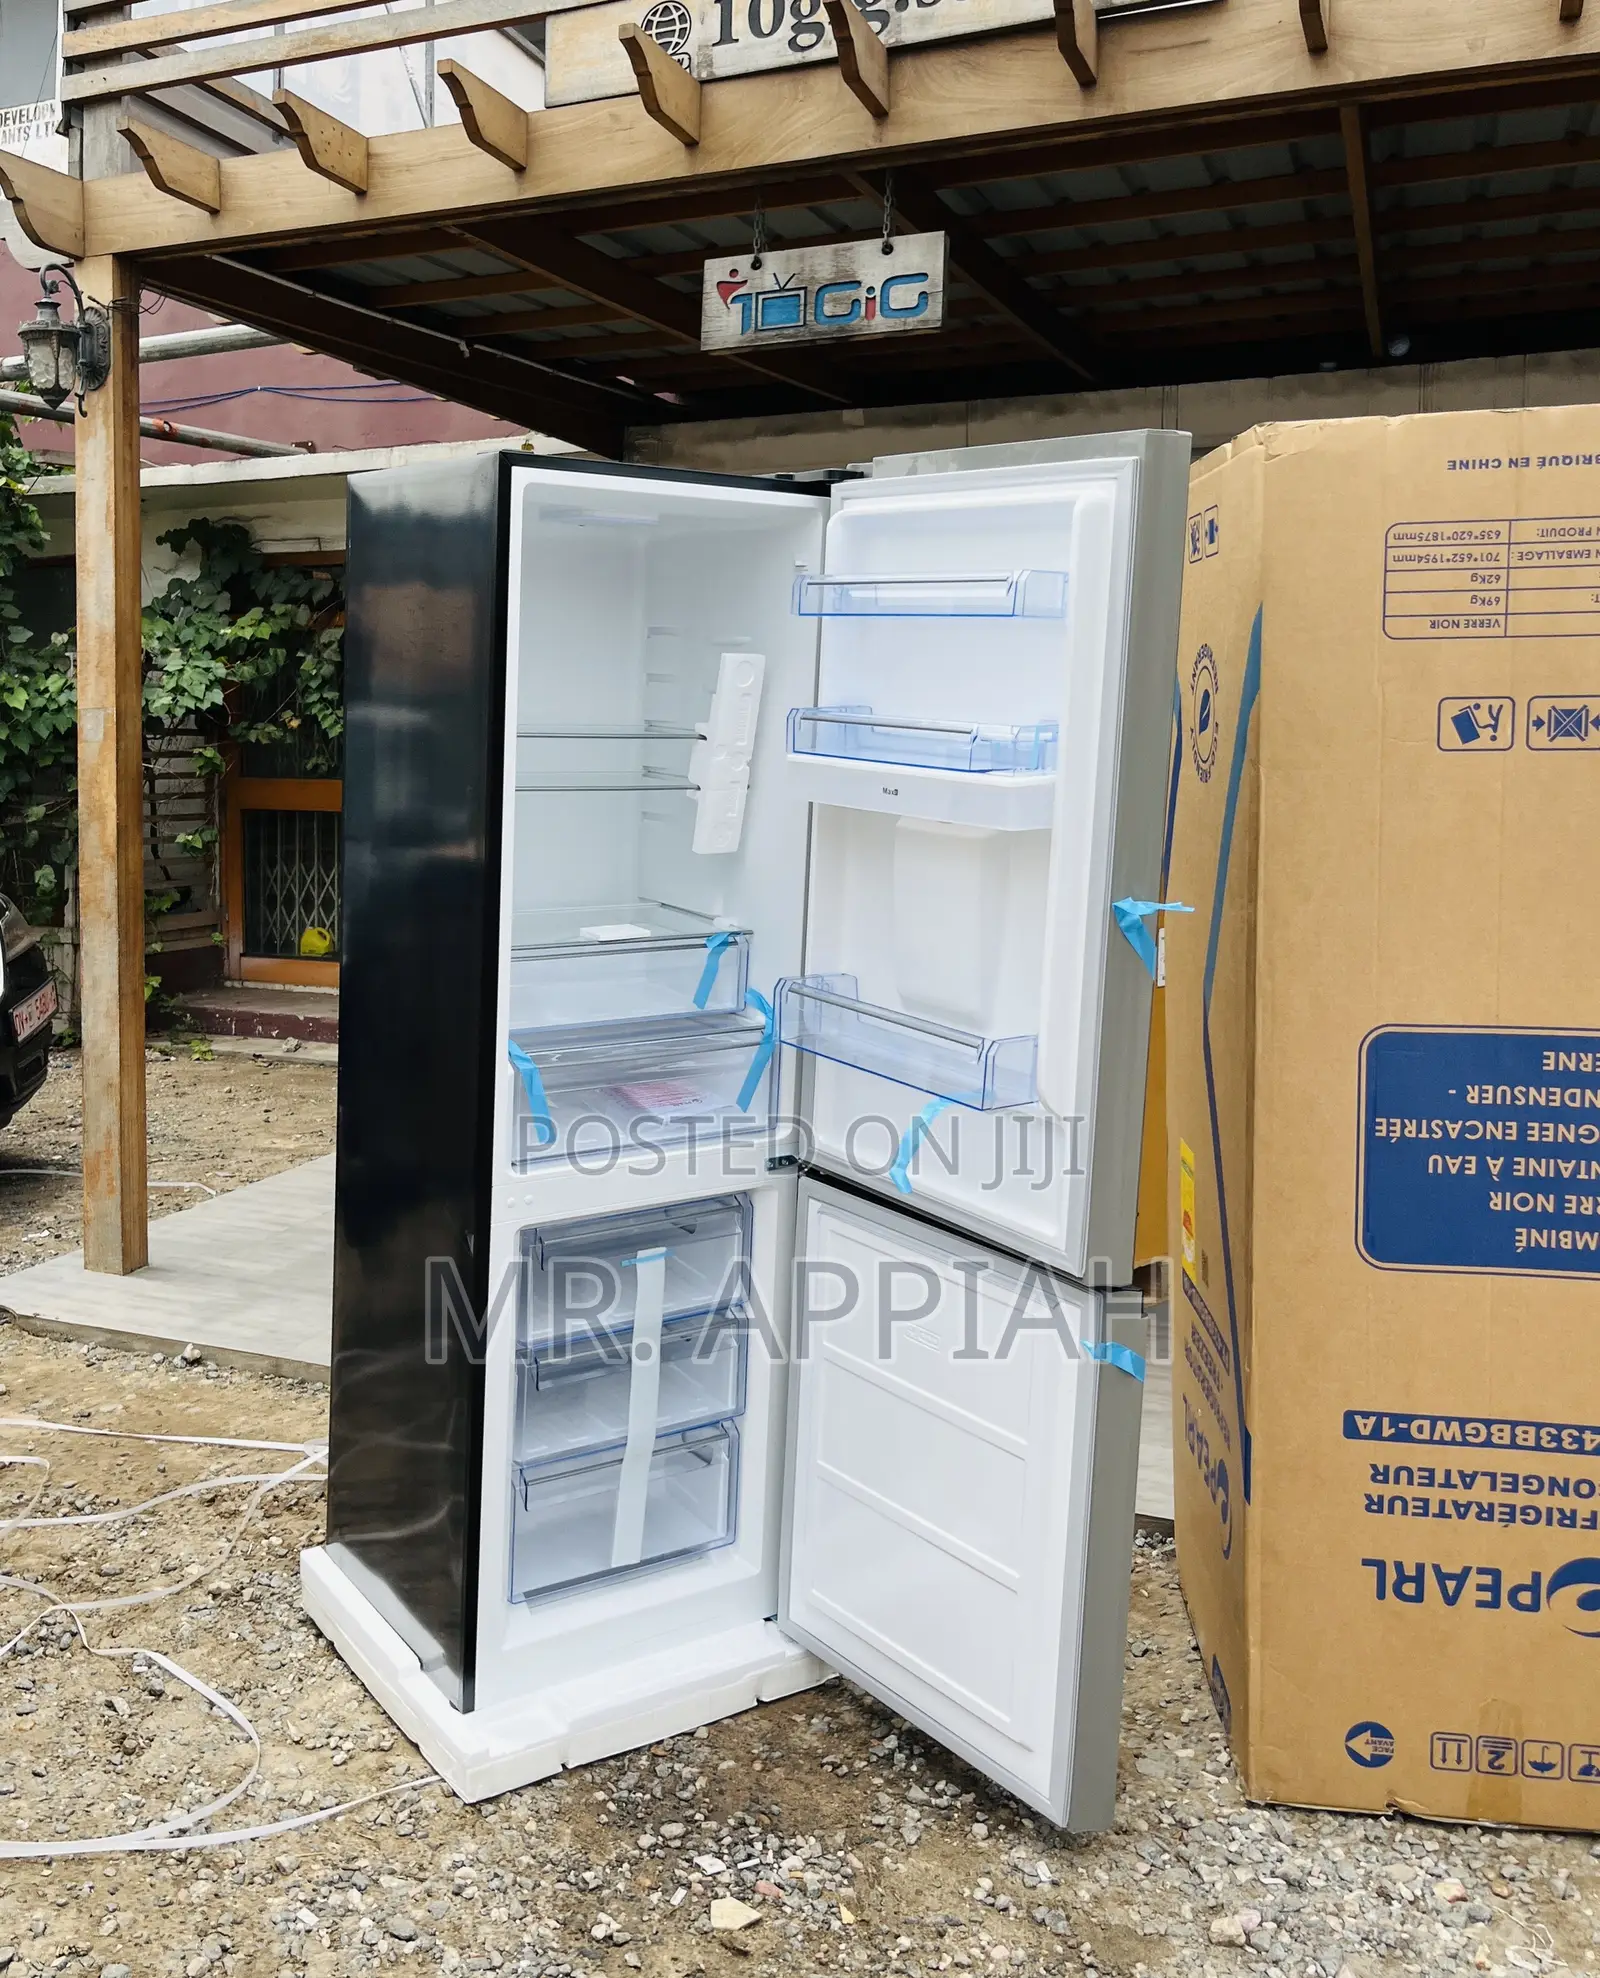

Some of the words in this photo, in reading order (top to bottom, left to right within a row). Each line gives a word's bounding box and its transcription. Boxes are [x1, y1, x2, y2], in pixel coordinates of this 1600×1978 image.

[1447, 458, 1502, 471] CHINE
[1508, 456, 1530, 469] EN
[1536, 526, 1592, 538] PRODUIT:
[1470, 572, 1501, 584] 62Kg
[1470, 594, 1501, 606] 69Kg
[1429, 619, 1460, 629] NOIR
[1464, 618, 1501, 629] VERRE
[1466, 1084, 1600, 1108] NDENSUER
[1375, 1117, 1517, 1144] ENCASTRÉE
[1527, 1122, 1600, 1145] GNEE
[1428, 1154, 1477, 1175] EAU
[1486, 1156, 1505, 1182] À
[1489, 1191, 1554, 1213] NOIR
[1515, 1227, 1599, 1253] MBINÉ
[1369, 1463, 1600, 1499] ONGELATEUR
[1364, 1493, 1600, 1530] FRIGÉRATEUR
[1361, 1558, 1542, 1613] PEARL
[1364, 1738, 1395, 1747] AVANT
[1372, 1746, 1395, 1754] FACE
